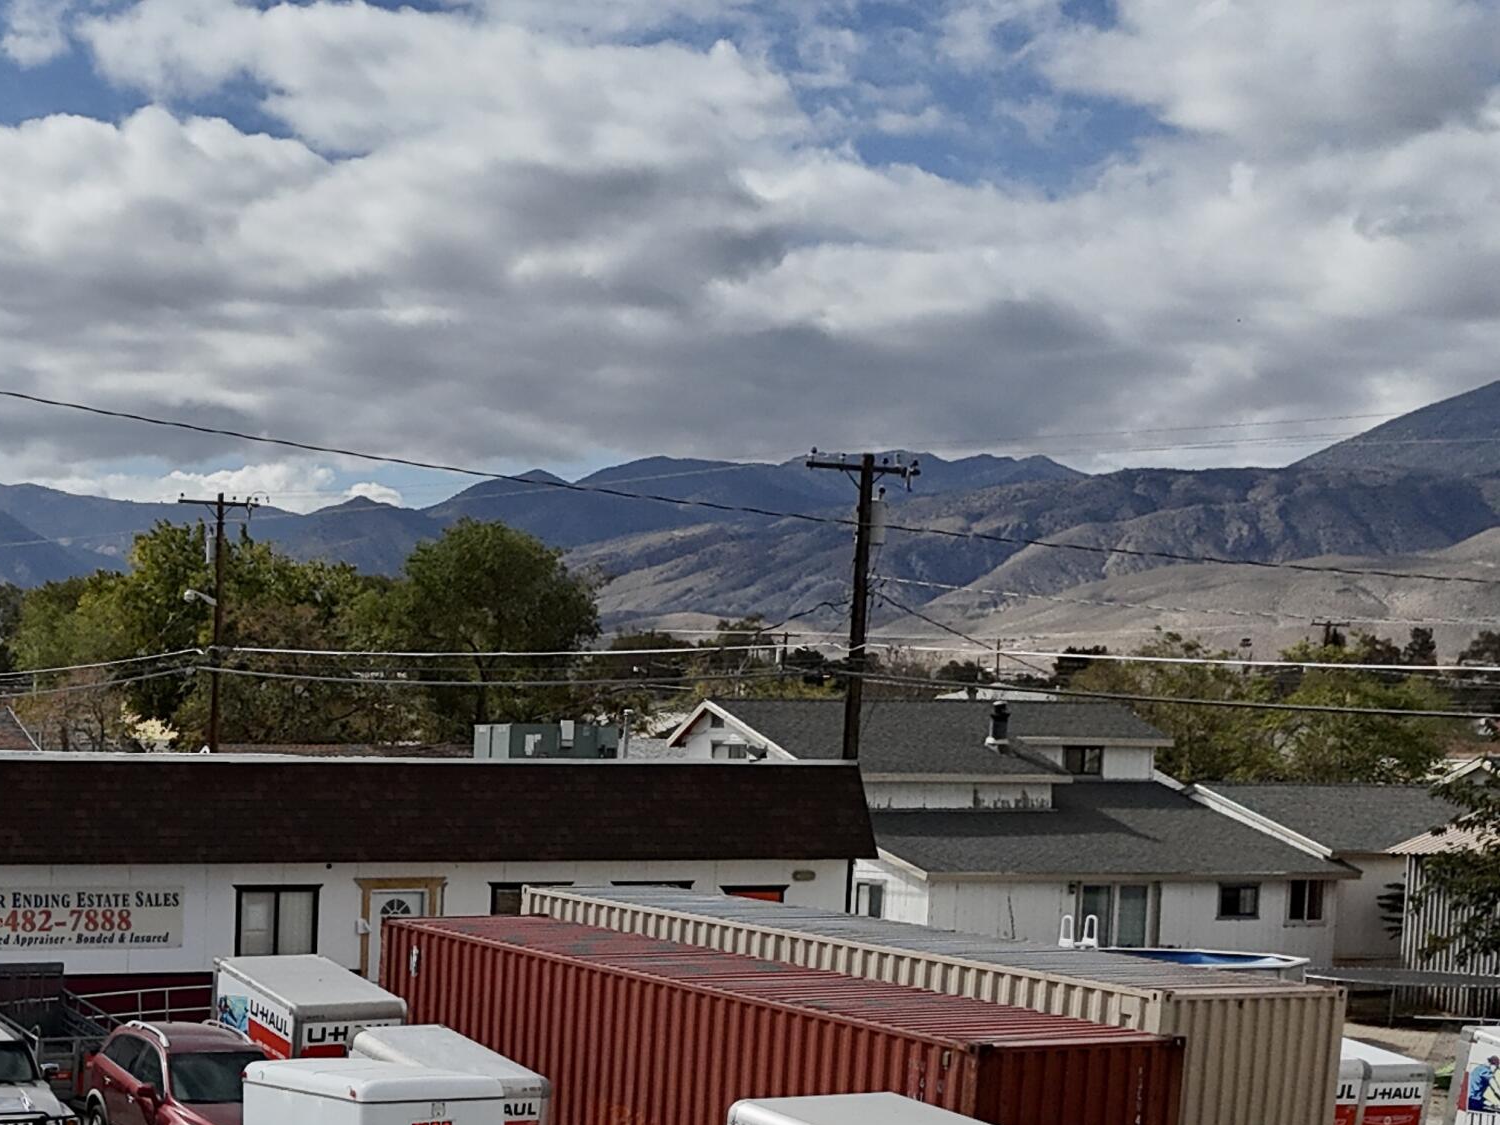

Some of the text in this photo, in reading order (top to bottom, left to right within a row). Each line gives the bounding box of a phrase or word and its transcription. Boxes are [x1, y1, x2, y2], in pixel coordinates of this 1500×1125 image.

[12, 892, 70, 908] ENDING
[77, 892, 130, 908] ESTATE
[136, 891, 179, 907] SALES
[13, 934, 65, 947] Appraiser
[76, 932, 115, 944] Bonded
[118, 933, 125, 944] &
[129, 932, 169, 943] Insured
[250, 999, 290, 1037] U-HAUL
